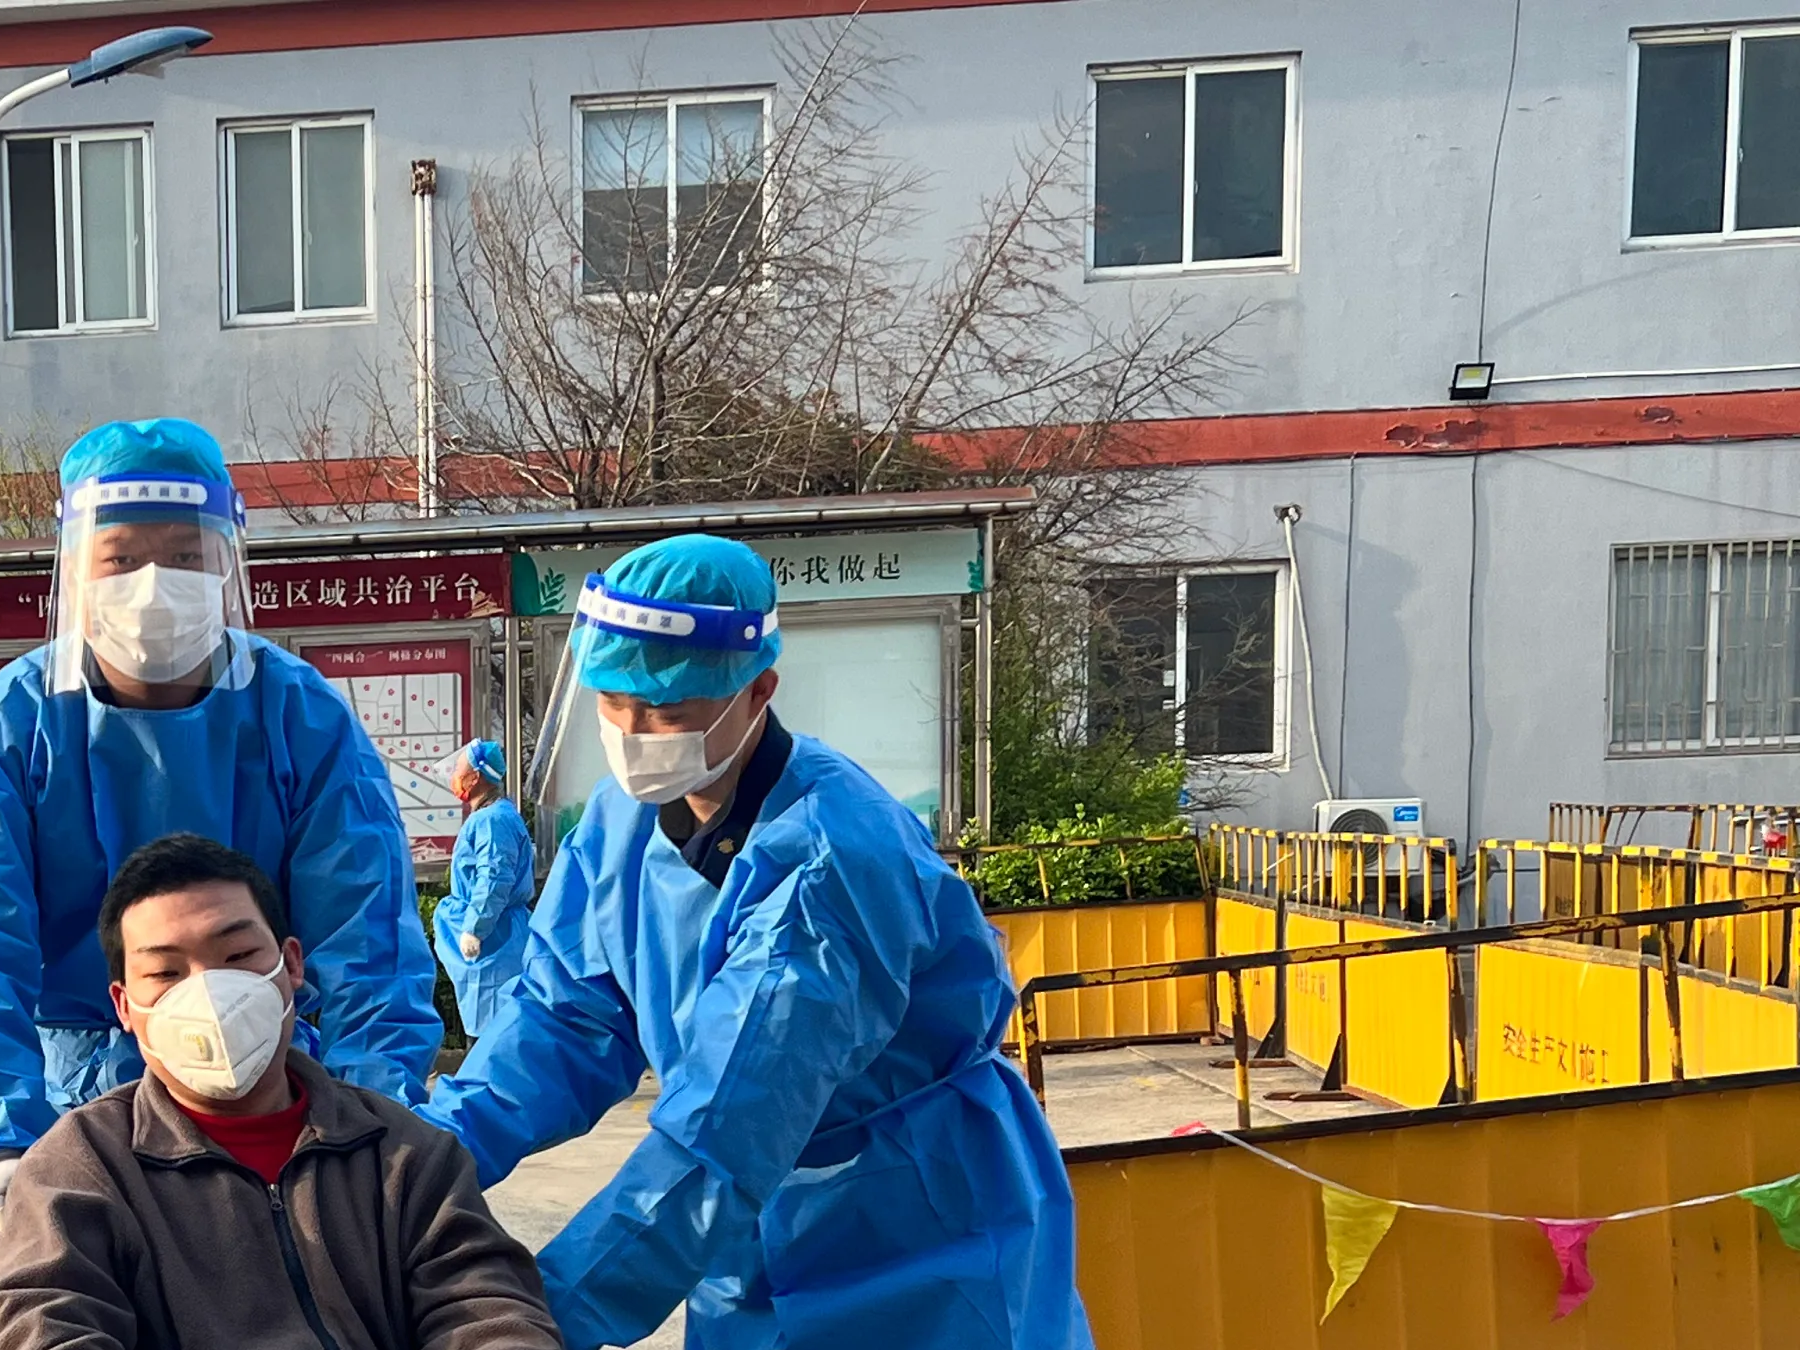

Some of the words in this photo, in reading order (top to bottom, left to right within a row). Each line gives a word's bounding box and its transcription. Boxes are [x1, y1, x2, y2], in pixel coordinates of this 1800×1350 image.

[769, 552, 901, 587] 你我做起
[1502, 1021, 1610, 1085] 安全生产文施工
